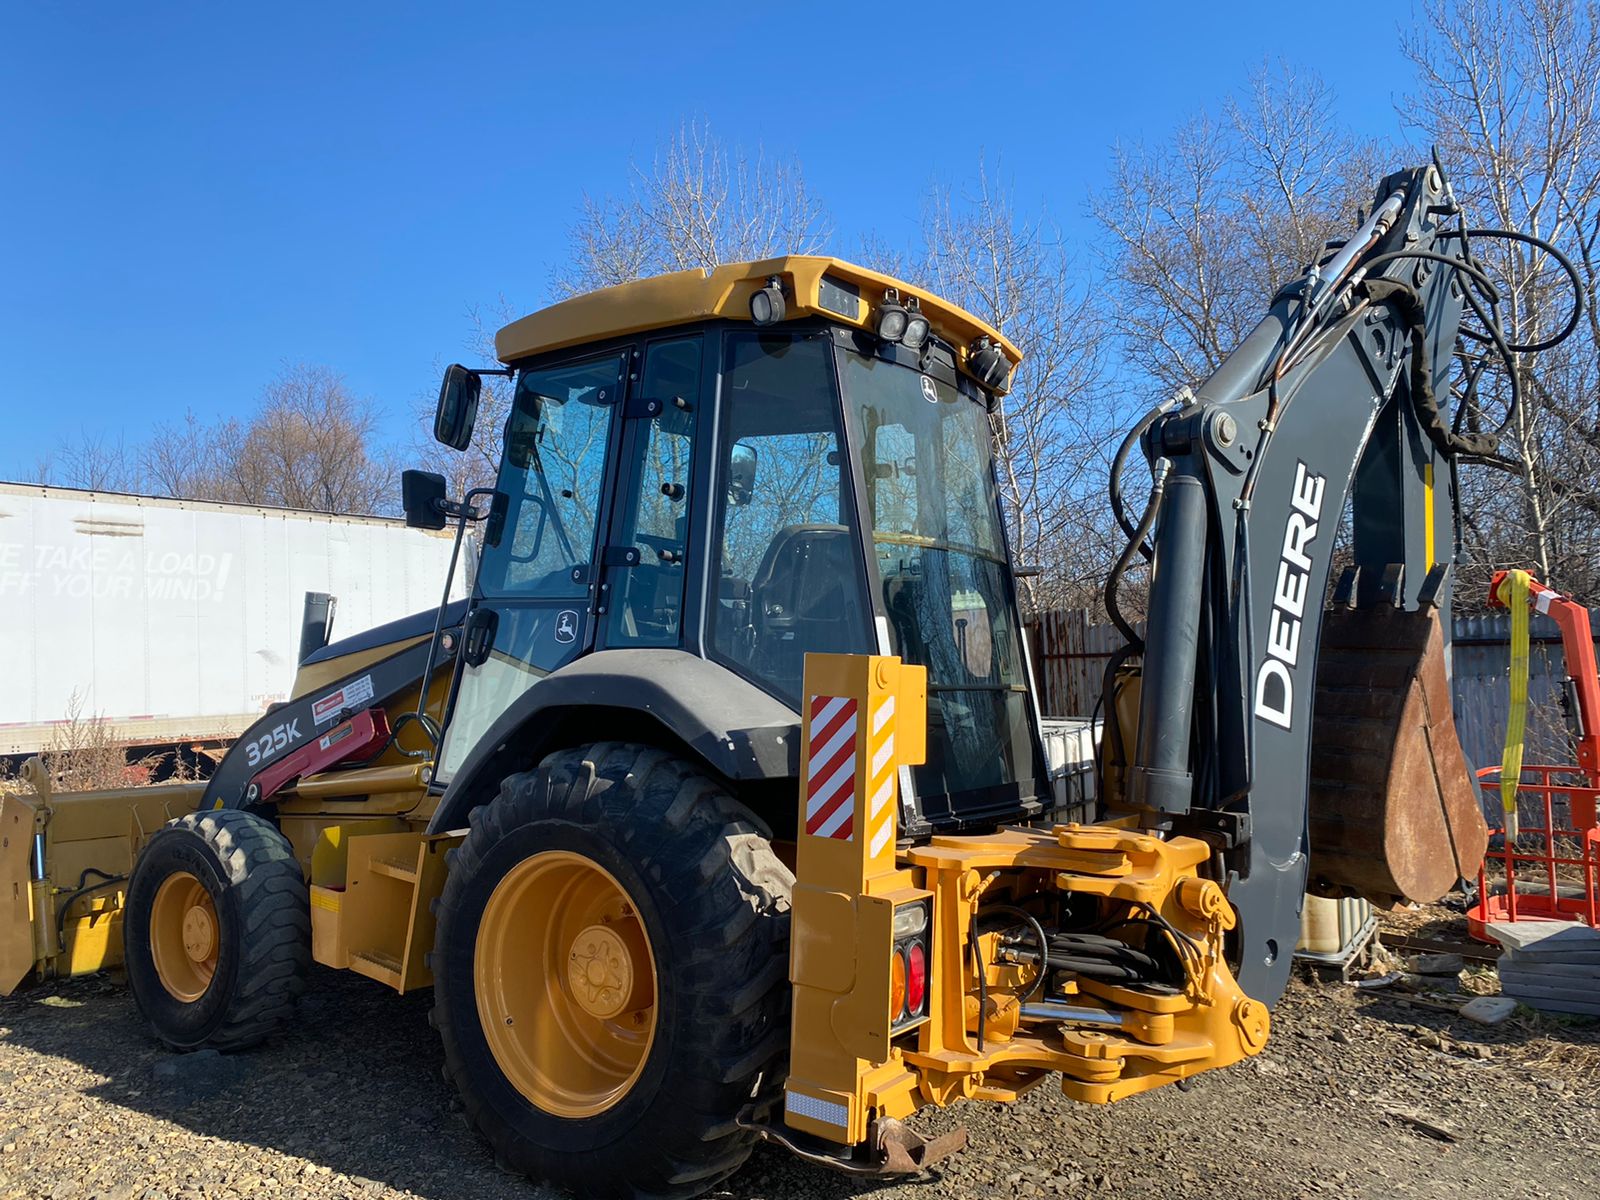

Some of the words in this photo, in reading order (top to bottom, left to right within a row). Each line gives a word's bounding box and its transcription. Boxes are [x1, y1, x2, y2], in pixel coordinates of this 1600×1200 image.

[0, 543, 25, 567] E
[35, 545, 113, 571] TAKE
[117, 548, 136, 572] A
[0, 571, 42, 597] FF
[52, 574, 134, 599] YOUR
[1255, 462, 1326, 729] DEERE
[246, 717, 302, 767] 325K
